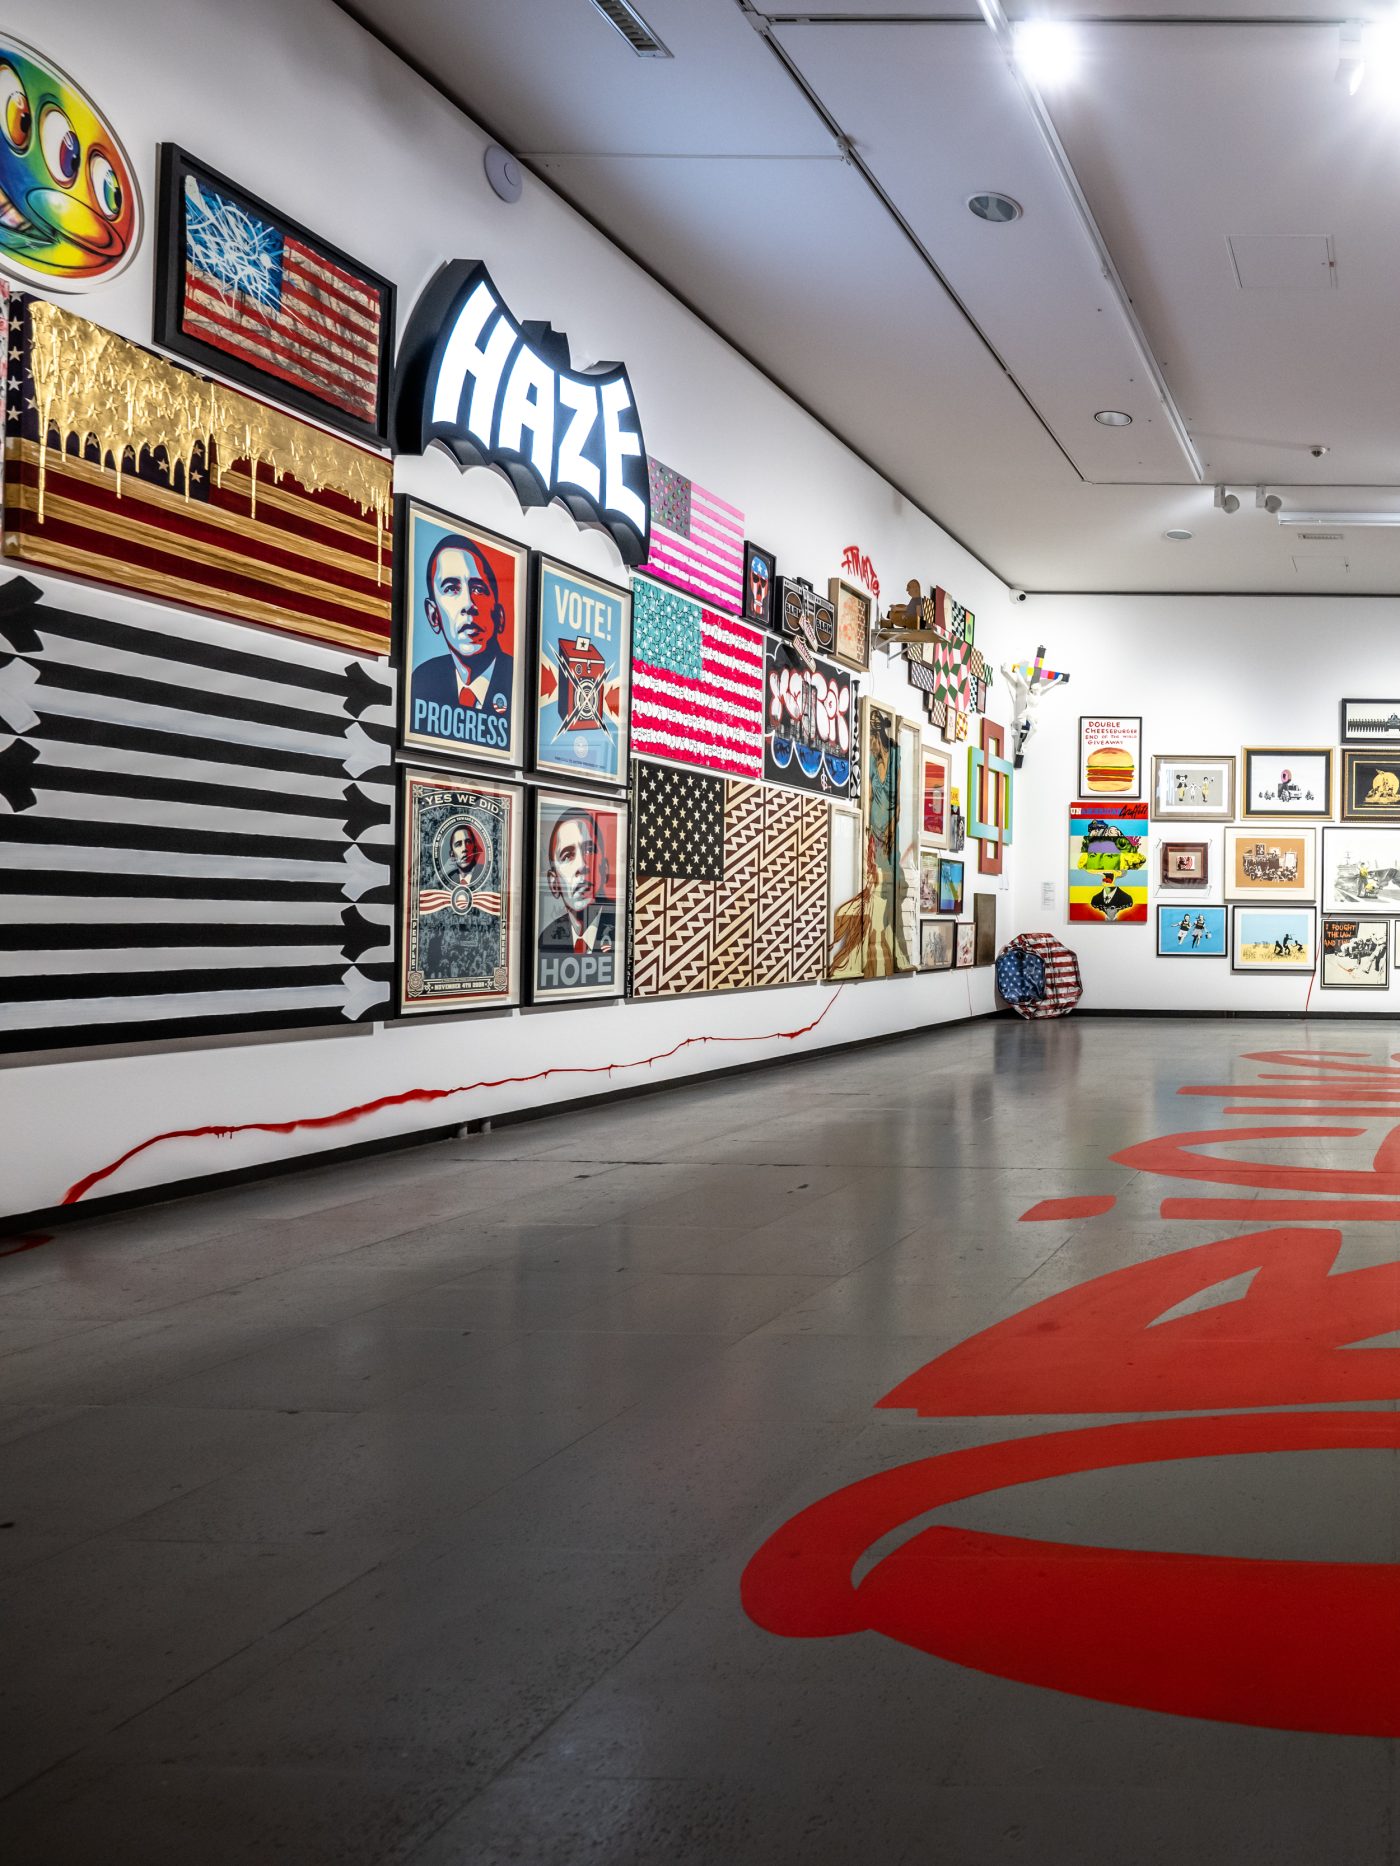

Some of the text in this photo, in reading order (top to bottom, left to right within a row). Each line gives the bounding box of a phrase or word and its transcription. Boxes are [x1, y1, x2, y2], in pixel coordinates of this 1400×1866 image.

[432, 281, 645, 537] HAZE
[554, 584, 613, 642] VOTE!
[414, 698, 508, 747] PROGRESS
[425, 793, 499, 814] YES WE DID
[1332, 923, 1356, 931] FOUGHT
[540, 956, 612, 987] HOPE
